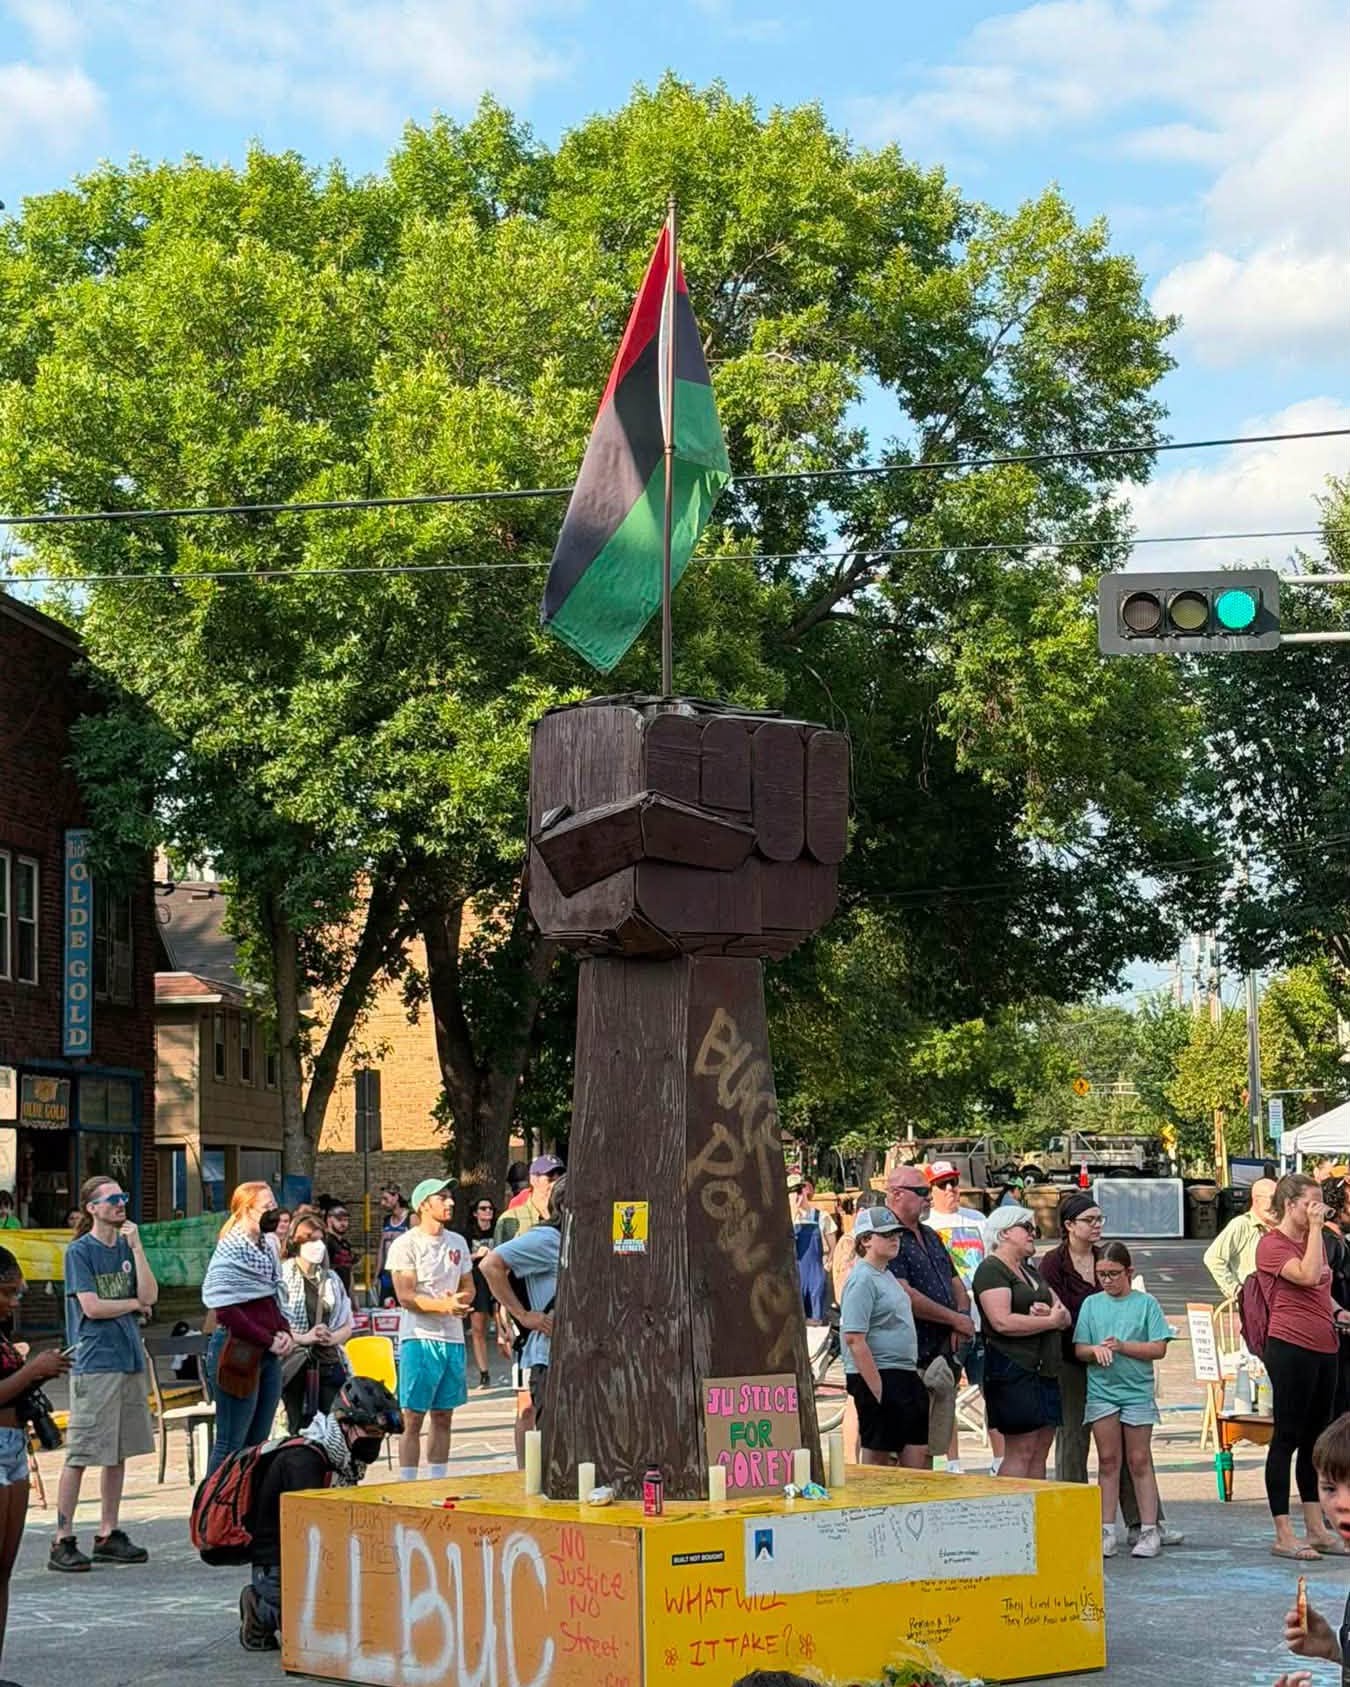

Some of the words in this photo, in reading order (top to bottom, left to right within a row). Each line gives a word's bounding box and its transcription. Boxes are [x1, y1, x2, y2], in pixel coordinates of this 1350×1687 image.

[69, 863, 89, 949] OLDE
[68, 959, 89, 1047] GOLD
[706, 1383, 799, 1417] JUSTICE
[730, 1419, 773, 1449] FOR
[716, 1448, 795, 1489] COREY
[560, 1528, 586, 1561] NO
[673, 1555, 688, 1564] BUILT
[689, 1554, 701, 1562] NOT
[701, 1552, 723, 1561] BOUGHT
[550, 1554, 625, 1601] Justice
[569, 1594, 600, 1618] NO
[664, 1581, 732, 1625] WHAT
[735, 1586, 788, 1614] WILL
[560, 1621, 619, 1659] Street
[688, 1639, 720, 1667] IT
[723, 1623, 793, 1657] TAKE?
